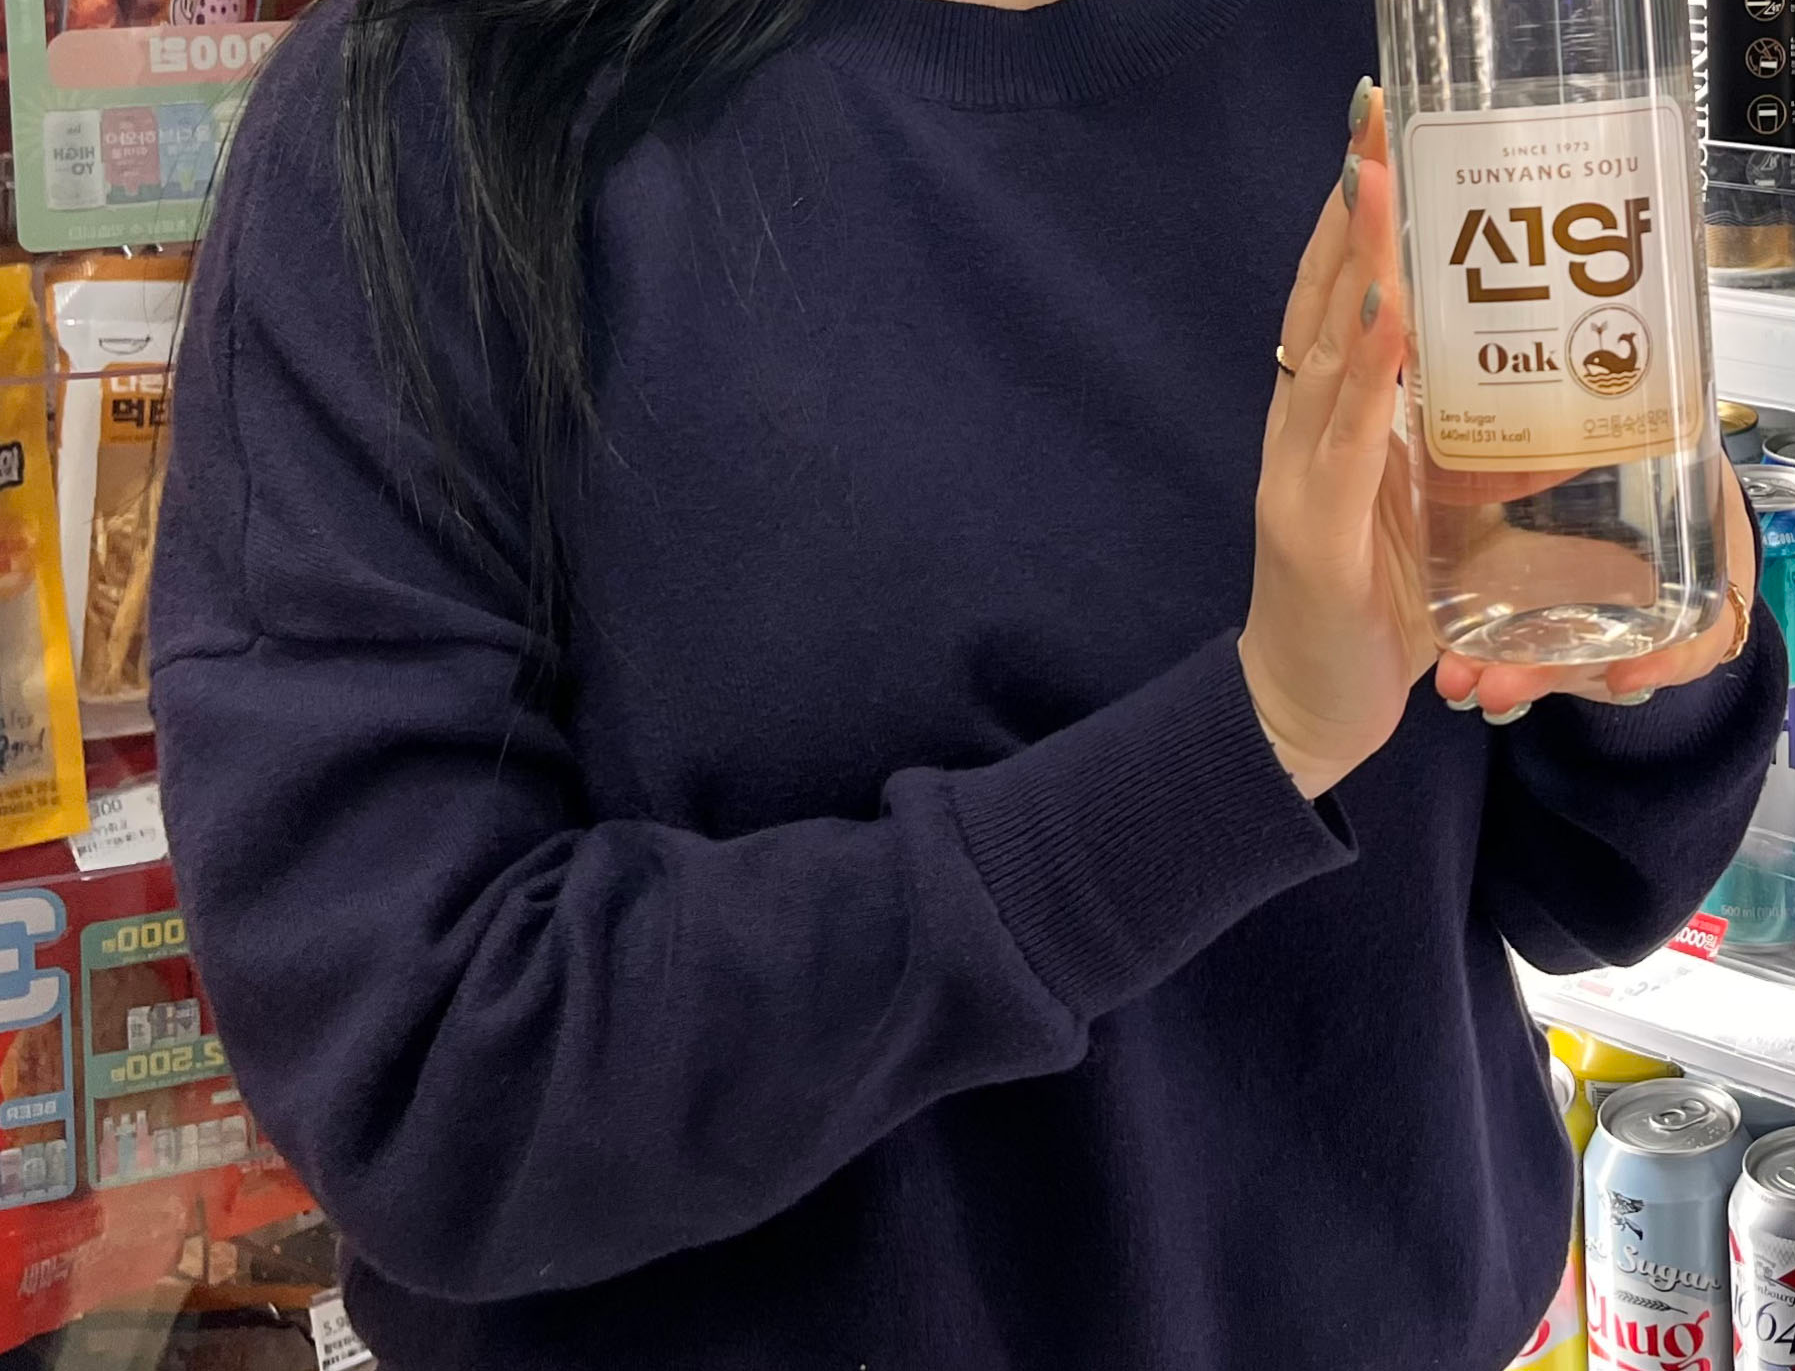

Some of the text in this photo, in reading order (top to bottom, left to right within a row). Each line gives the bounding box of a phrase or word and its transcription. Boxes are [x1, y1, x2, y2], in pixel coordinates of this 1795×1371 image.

[1502, 141, 1590, 157] SINCE 1973
[1455, 157, 1639, 185] SUNYANG SOJU
[1448, 196, 1653, 304] 선양
[1477, 341, 1560, 375] Oak
[1440, 410, 1497, 427] Zero Sugar
[1617, 1244, 1722, 1293] Sugar
